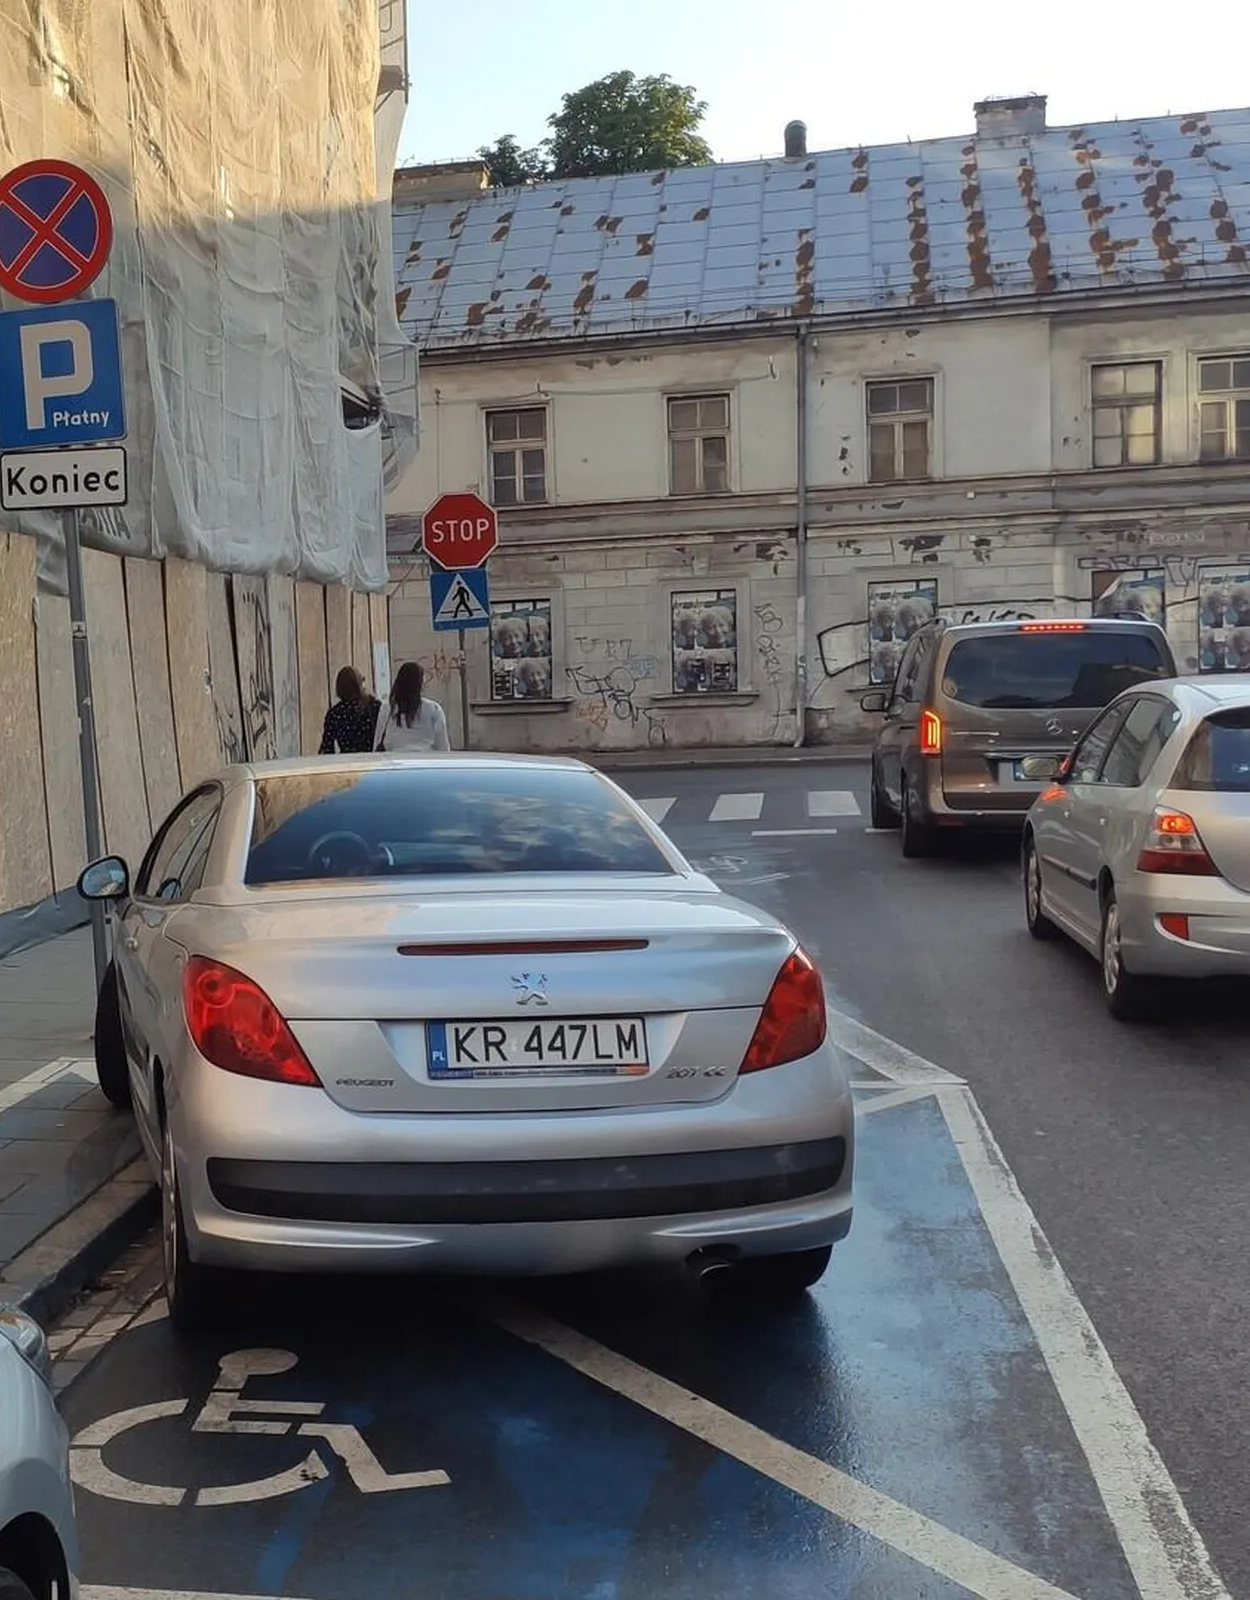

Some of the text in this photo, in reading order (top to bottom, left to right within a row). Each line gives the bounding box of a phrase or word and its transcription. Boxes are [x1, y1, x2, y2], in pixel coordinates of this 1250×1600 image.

[19, 319, 94, 430] P
[53, 411, 110, 428] Płatny
[6, 463, 120, 497] Koniec
[431, 518, 490, 543] STOP
[432, 1051, 446, 1062] PL
[453, 1023, 639, 1063] KR 447LM
